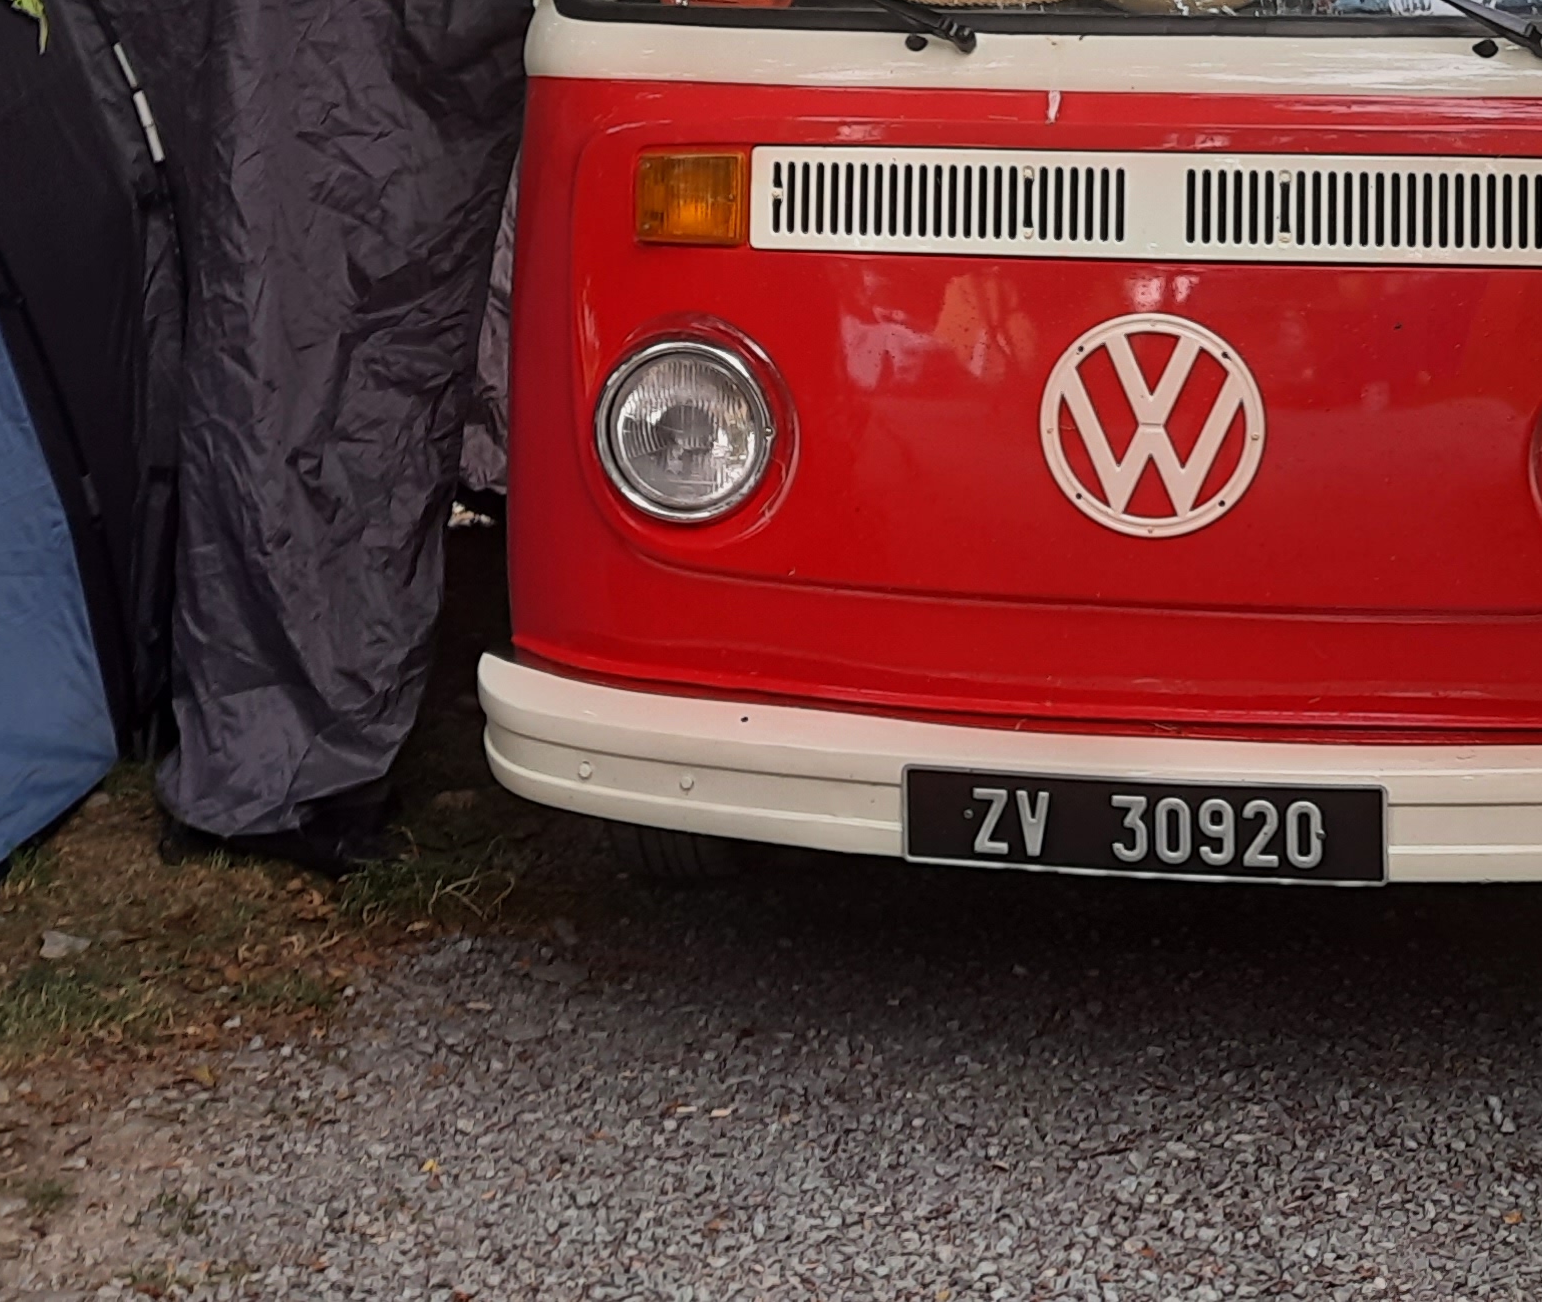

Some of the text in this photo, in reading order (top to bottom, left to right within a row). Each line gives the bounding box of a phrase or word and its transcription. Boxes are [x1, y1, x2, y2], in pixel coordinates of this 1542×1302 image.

[1051, 323, 1256, 527] VW
[972, 787, 1325, 869] ZV 30920
